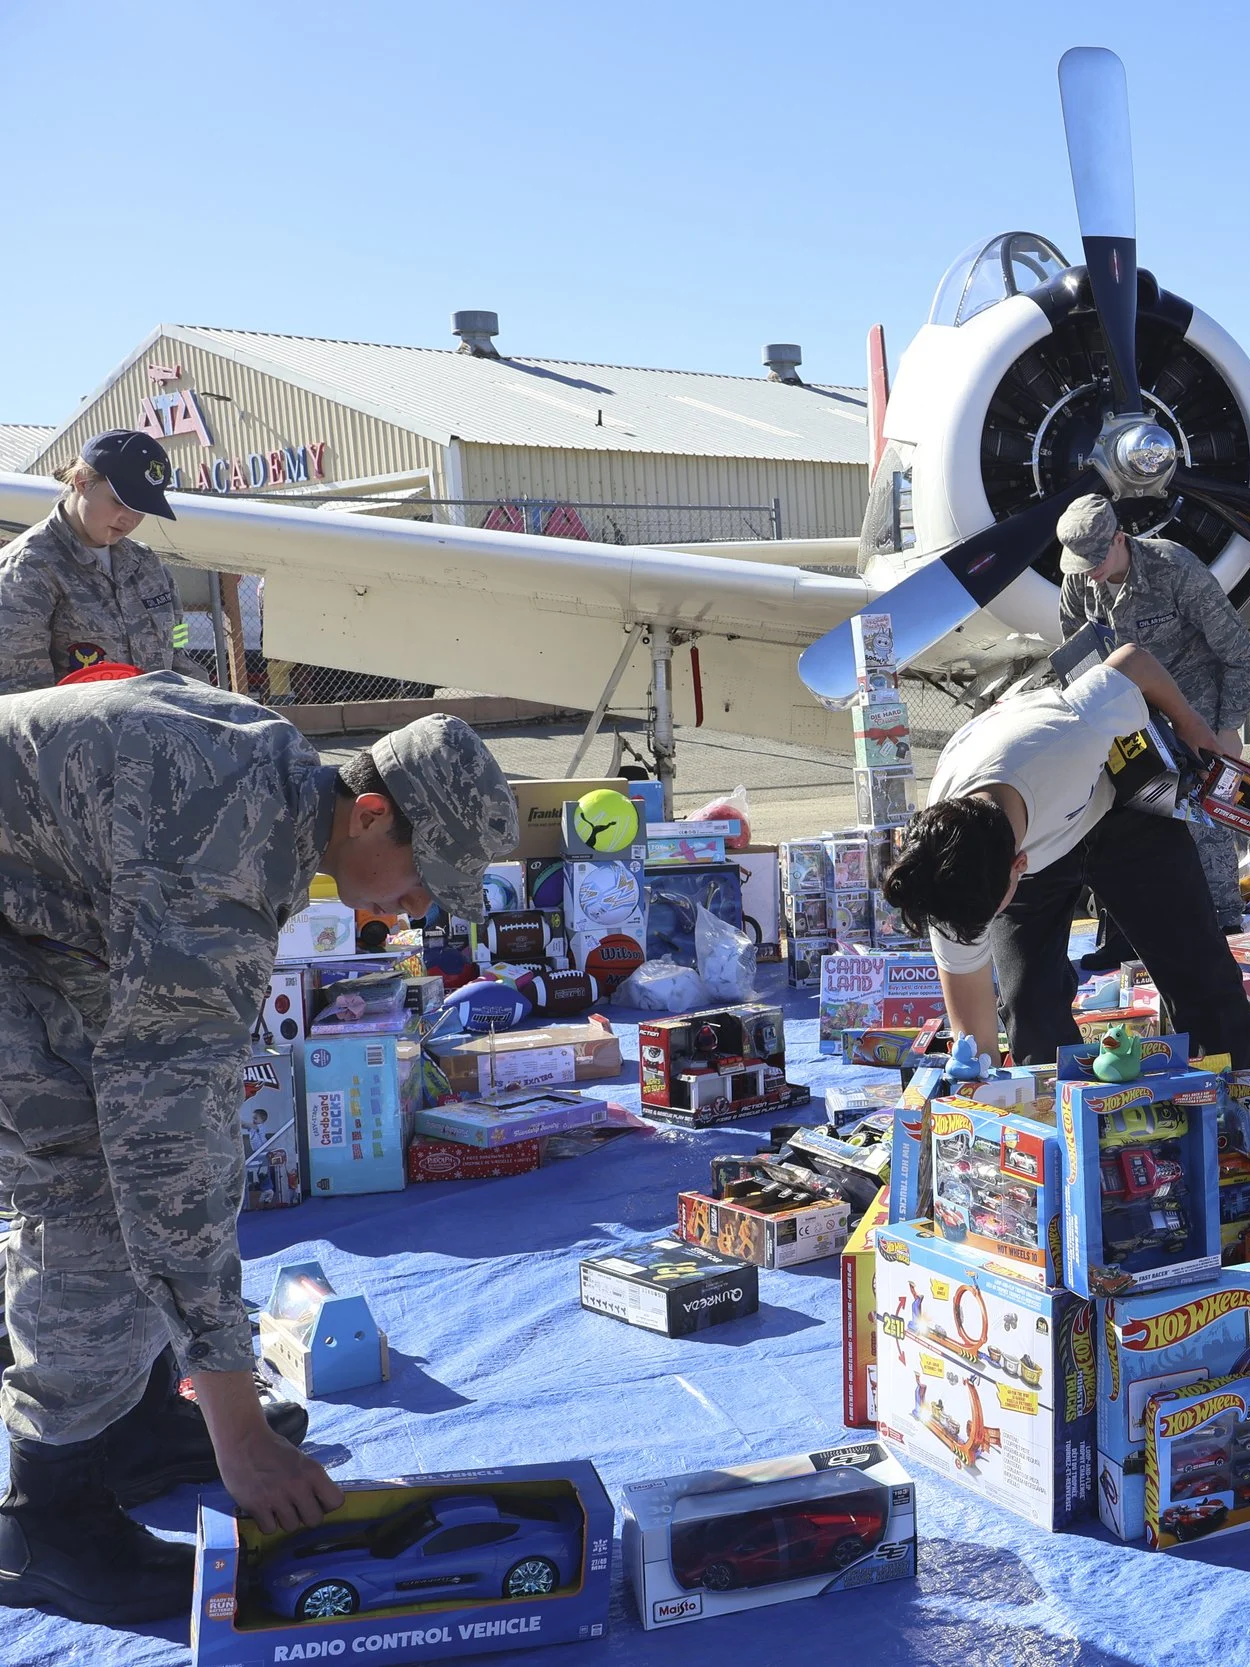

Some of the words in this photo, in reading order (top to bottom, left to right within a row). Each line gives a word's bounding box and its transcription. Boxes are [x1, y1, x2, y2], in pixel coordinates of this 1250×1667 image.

[137, 390, 214, 447] ATA
[196, 442, 325, 494] ACADEMY
[883, 709, 901, 718] HARD
[824, 957, 884, 975] CANDY
[890, 967, 941, 981] MONO
[827, 975, 873, 992] LAND
[523, 1072, 554, 1085] DELUXE
[741, 1101, 767, 1112] ACTION
[761, 1105, 779, 1114] PLAY
[1101, 1093, 1120, 1112] HOT
[1119, 1087, 1152, 1105] WHEELS
[318, 1094, 331, 1146] Cardboard
[330, 1093, 343, 1145] BLOCKS
[934, 1113, 949, 1134] HOT
[948, 1115, 972, 1135] WHEELS
[901, 1172, 909, 1210] TRUCKS
[997, 1243, 1009, 1256] HOT
[1009, 1245, 1030, 1261] WHEELS
[1031, 1252, 1037, 1262] 10
[1138, 1273, 1151, 1283] FAST
[1151, 1270, 1169, 1280] RACER
[682, 1287, 743, 1313] QUNREDA
[1143, 1314, 1189, 1350] HOT
[1065, 1371, 1077, 1423] TRUCKS
[1165, 1409, 1197, 1436] HOT
[1196, 1397, 1241, 1426] WHEELS
[440, 1469, 505, 1479] VEHICLE
[214, 1561, 225, 1569] 3+
[209, 1601, 234, 1609] RUN
[658, 1598, 697, 1618] Maisto
[273, 1634, 347, 1663] RADIO
[350, 1625, 455, 1655] CONTROL
[458, 1615, 542, 1642] VEHICLE
